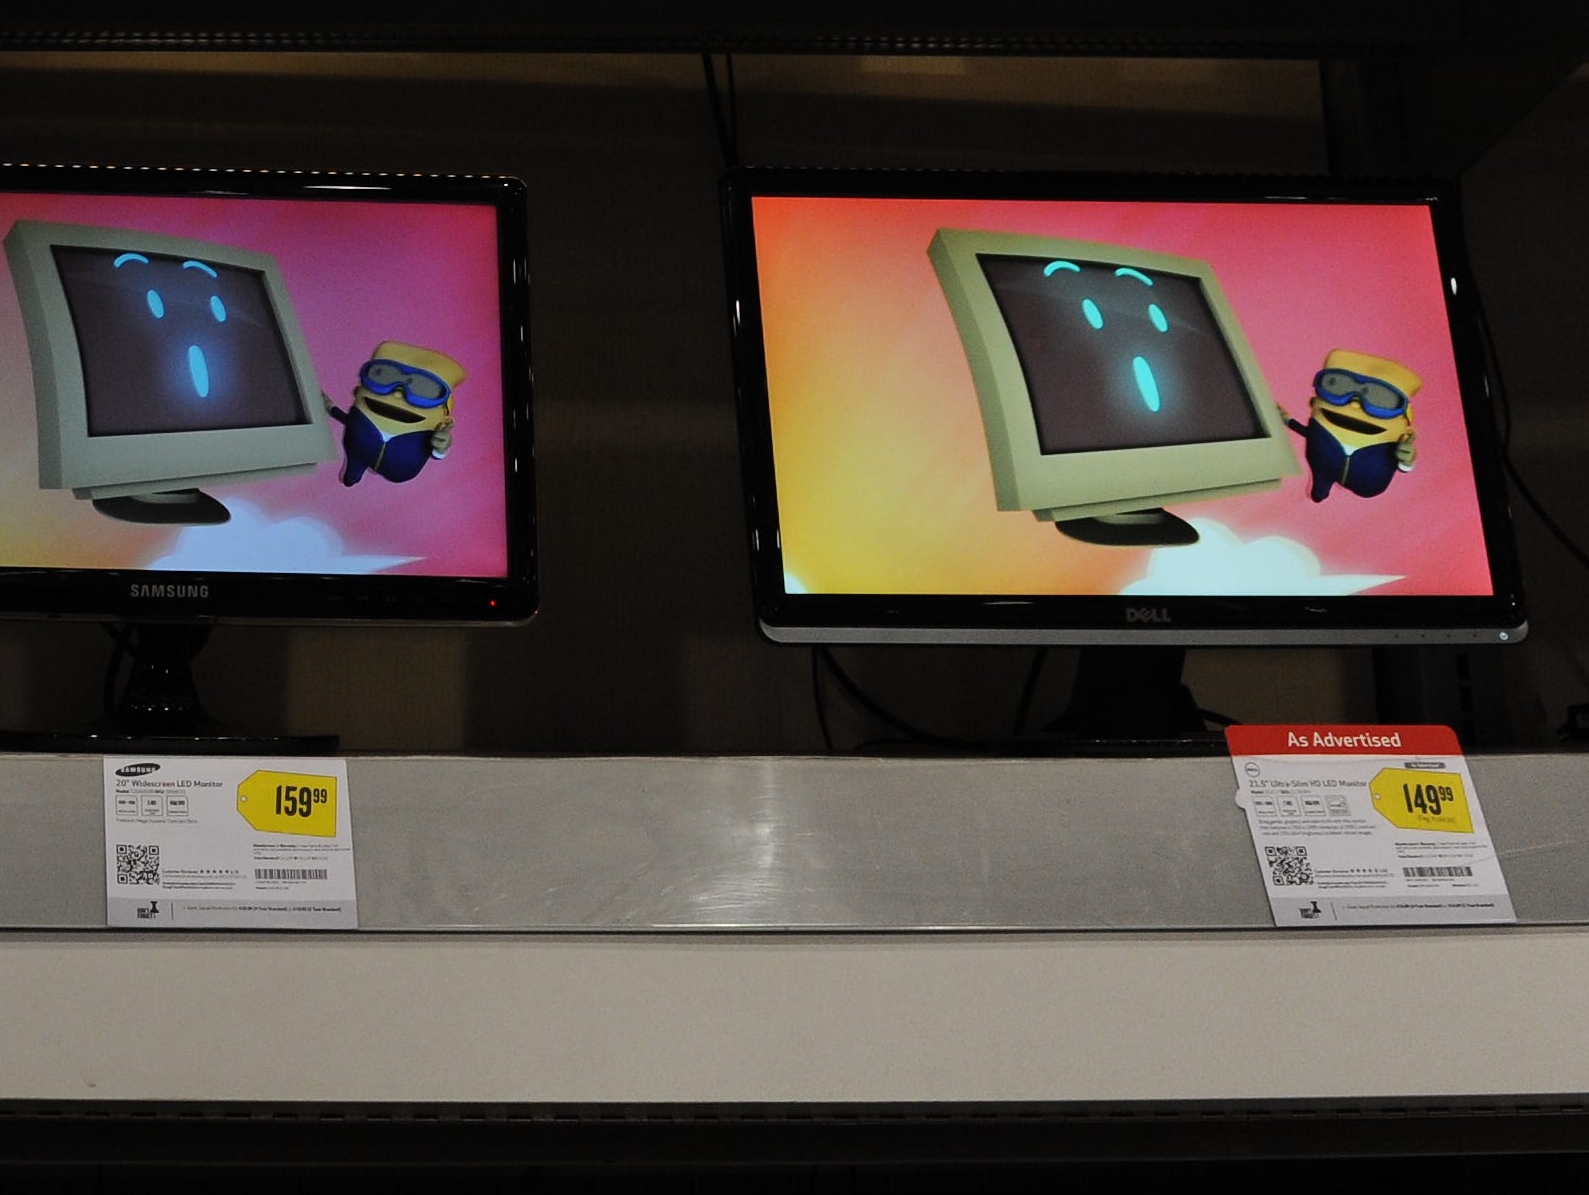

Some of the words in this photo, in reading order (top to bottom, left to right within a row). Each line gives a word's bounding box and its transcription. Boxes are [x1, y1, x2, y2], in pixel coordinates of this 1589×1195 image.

[130, 583, 209, 600] SAMSUNG
[1126, 607, 1172, 624] DELL
[1287, 732, 1309, 748] As
[1312, 732, 1401, 748] Advertised
[131, 779, 175, 788] Widescreen
[176, 780, 192, 788] LED
[193, 780, 223, 788] Monitor
[1323, 779, 1337, 788] LED
[1339, 780, 1367, 788] Monitor
